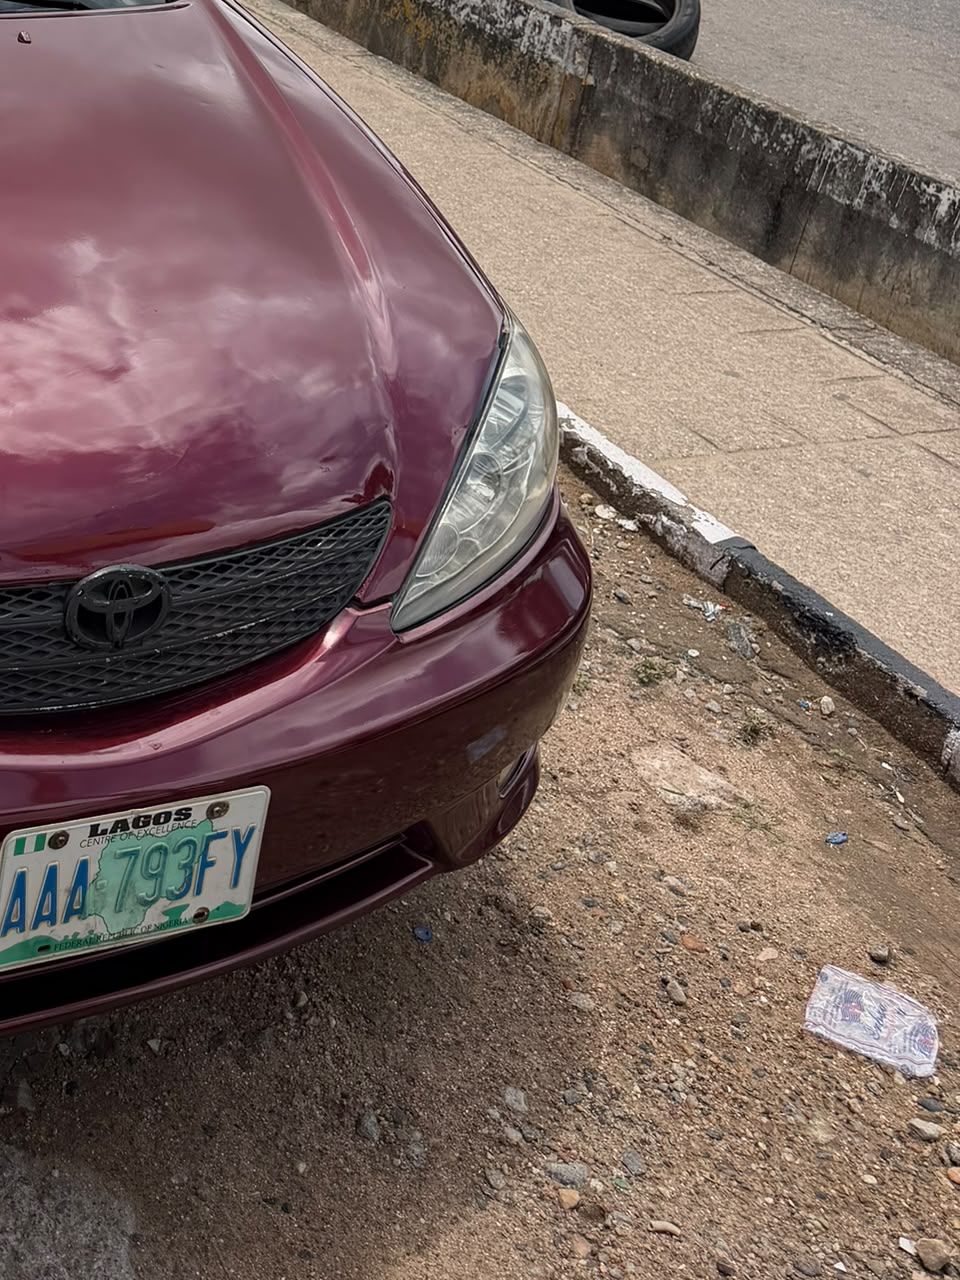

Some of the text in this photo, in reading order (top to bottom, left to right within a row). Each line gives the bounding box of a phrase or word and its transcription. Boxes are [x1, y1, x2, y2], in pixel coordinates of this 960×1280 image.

[79, 819, 198, 849] CENTRE OF EXCELLENCE
[88, 806, 193, 839] LAGOS
[53, 935, 95, 952] FEDERAL
[154, 918, 190, 932] NIGERIA
